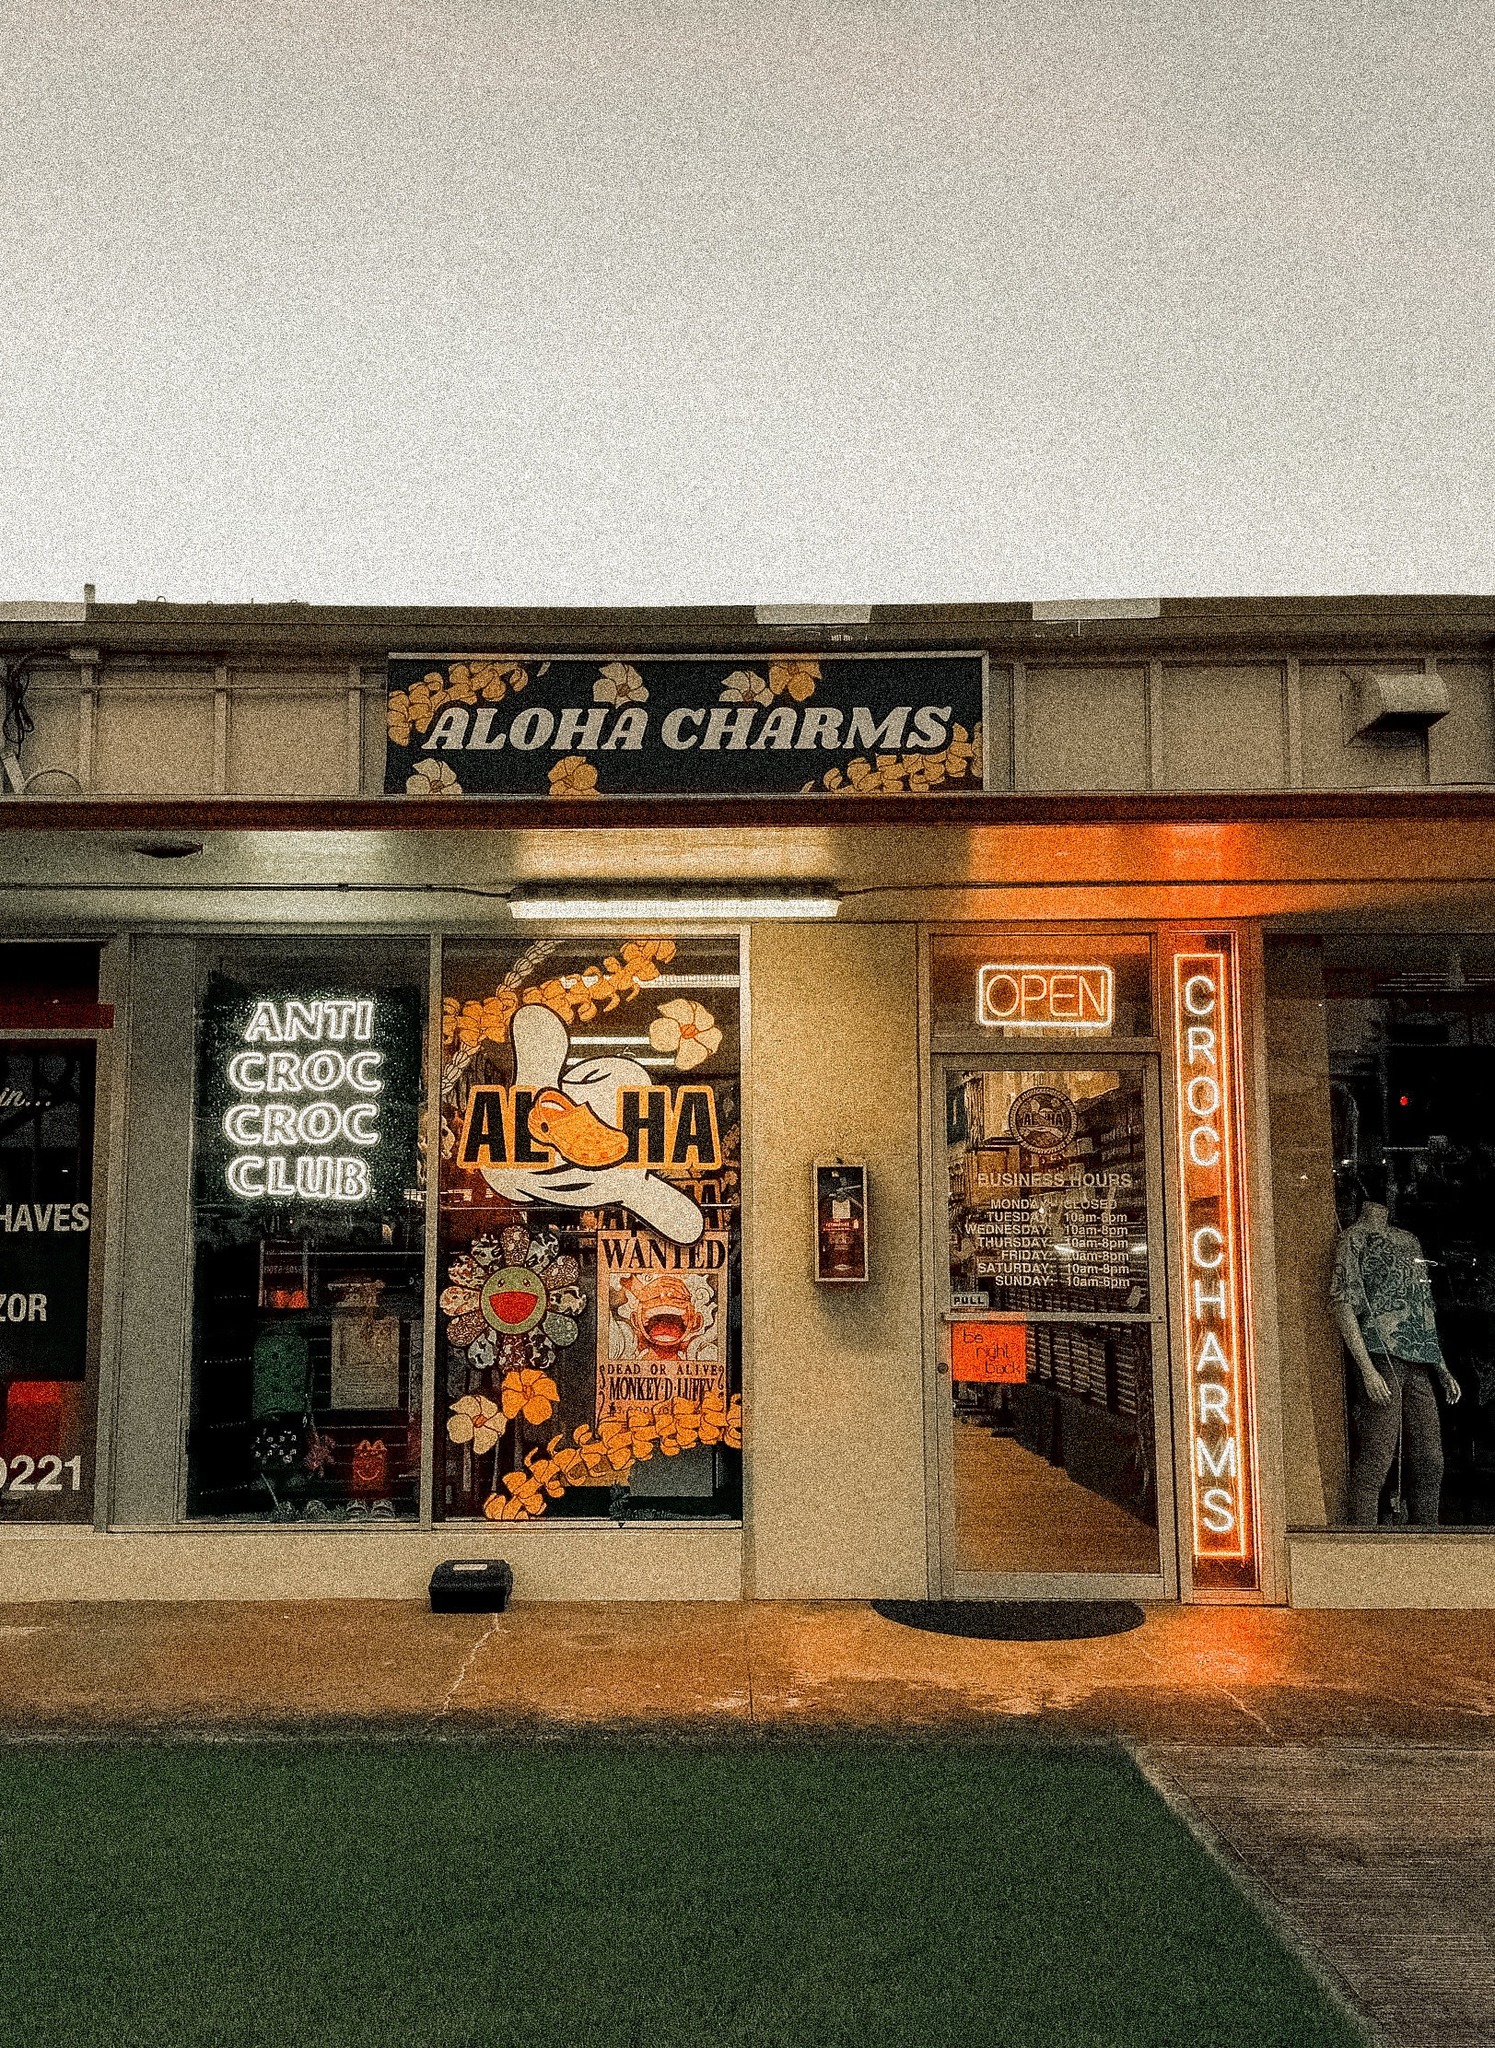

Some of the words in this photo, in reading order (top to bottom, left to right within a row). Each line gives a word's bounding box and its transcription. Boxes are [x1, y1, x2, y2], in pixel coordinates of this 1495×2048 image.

[422, 706, 644, 750] ALOHA
[660, 705, 954, 750] CHARMS
[985, 972, 1106, 1019] OPEN
[244, 999, 375, 1042] ANTI
[228, 1050, 384, 1093] CROC
[1182, 975, 1222, 1168] CROC
[222, 1101, 381, 1147] CROC
[458, 1085, 721, 1168] ALHA
[226, 1155, 371, 1201] CLUB
[977, 1173, 1065, 1187] BUSINESS
[1070, 1173, 1133, 1187] HOURS
[1063, 1199, 1117, 1210] CLOSED
[965, 1224, 1052, 1235] WEDNESDAY:
[1065, 1225, 1129, 1238] 10am-8pm
[600, 1239, 726, 1269] WANTED
[977, 1263, 1054, 1273] SATURDAY:
[1067, 1264, 1130, 1277] 10am-8pm
[995, 1276, 1054, 1286] SUNDAY:
[1066, 1276, 1130, 1289] 10am-6pm
[953, 1296, 984, 1305] PULL
[962, 1327, 983, 1343] be
[976, 1341, 1009, 1361] right
[607, 1364, 640, 1375] DEAD
[650, 1364, 667, 1375] OR
[676, 1364, 718, 1376] ALIVE
[984, 1360, 1021, 1375] back
[1192, 1225, 1237, 1535] CHARMS
